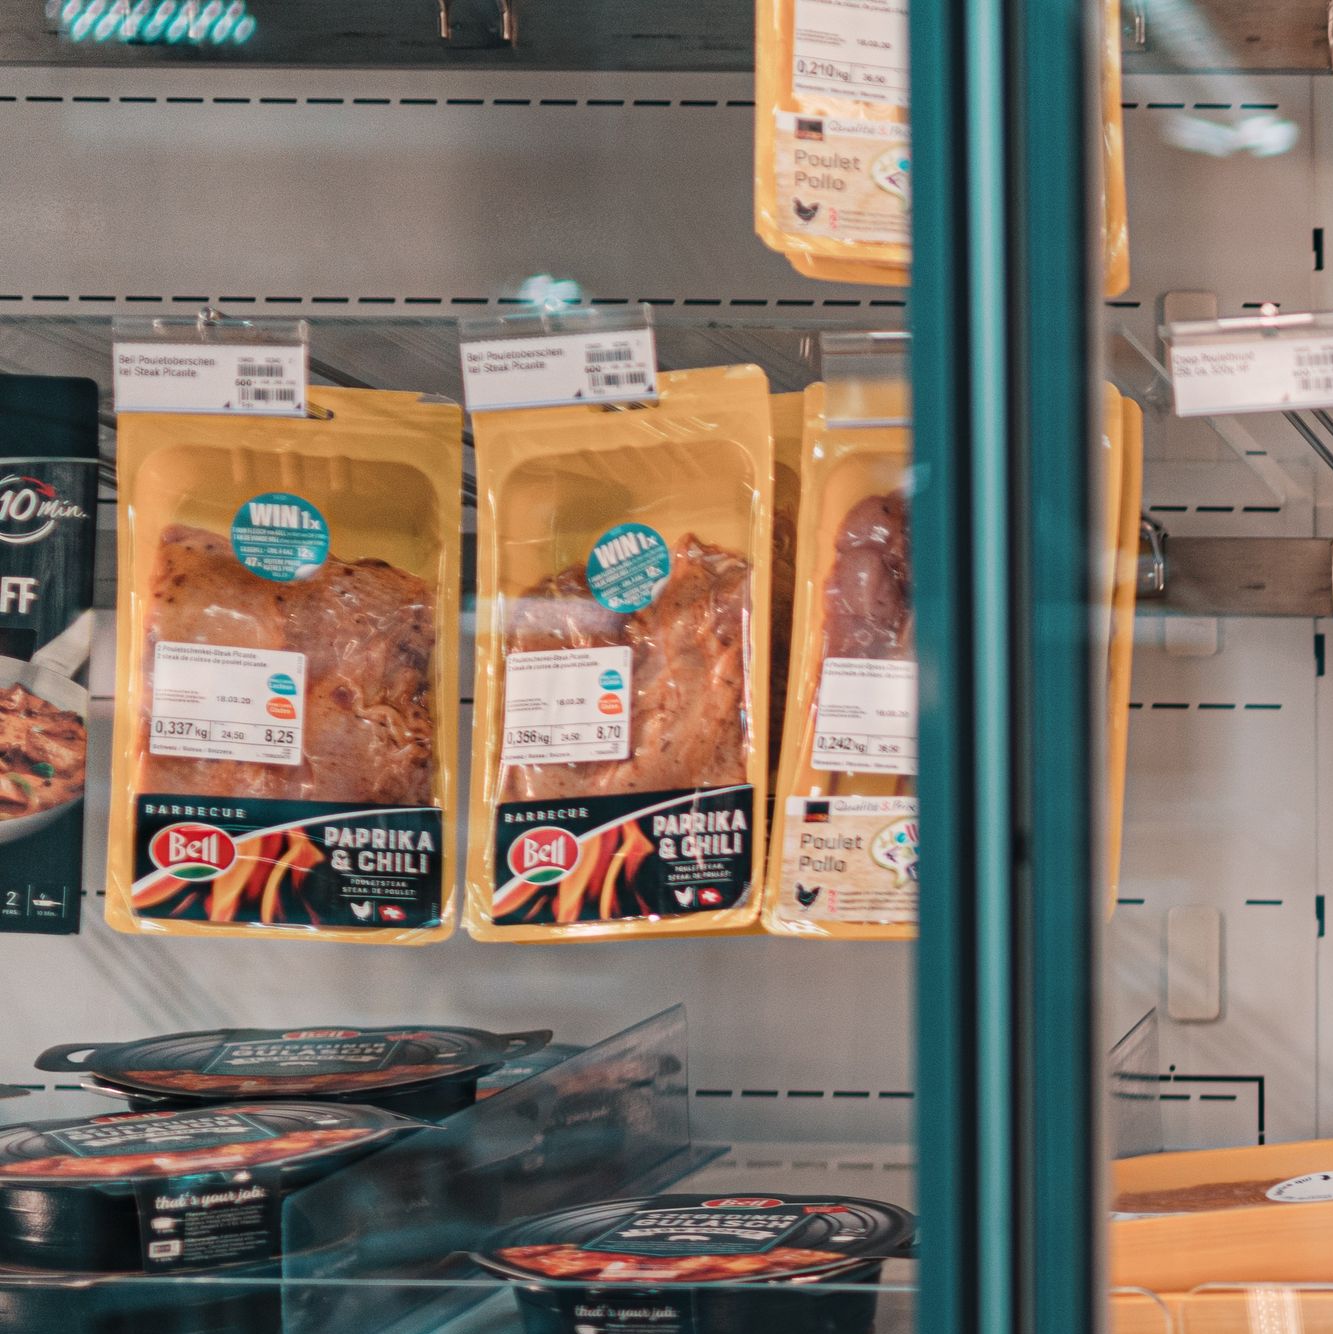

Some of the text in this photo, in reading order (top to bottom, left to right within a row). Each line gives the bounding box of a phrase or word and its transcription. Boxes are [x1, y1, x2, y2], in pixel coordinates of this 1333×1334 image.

[794, 149, 860, 171] Poulet
[794, 172, 846, 192] Pollo
[249, 502, 298, 528] WIN
[594, 532, 640, 569] WIN
[155, 720, 295, 744] 0,337 kg 8,25
[145, 804, 247, 819] BARBECUE
[653, 809, 748, 836] PAPRIKA
[168, 831, 219, 865] Bell
[324, 826, 436, 852] PAPRIKA
[681, 832, 742, 857] CHILI
[800, 832, 863, 851] Poulet
[331, 850, 430, 874] & CHILI
[523, 837, 566, 867] Bell
[799, 857, 847, 873] Pollo
[632, 1219, 792, 1228] GULASCH
